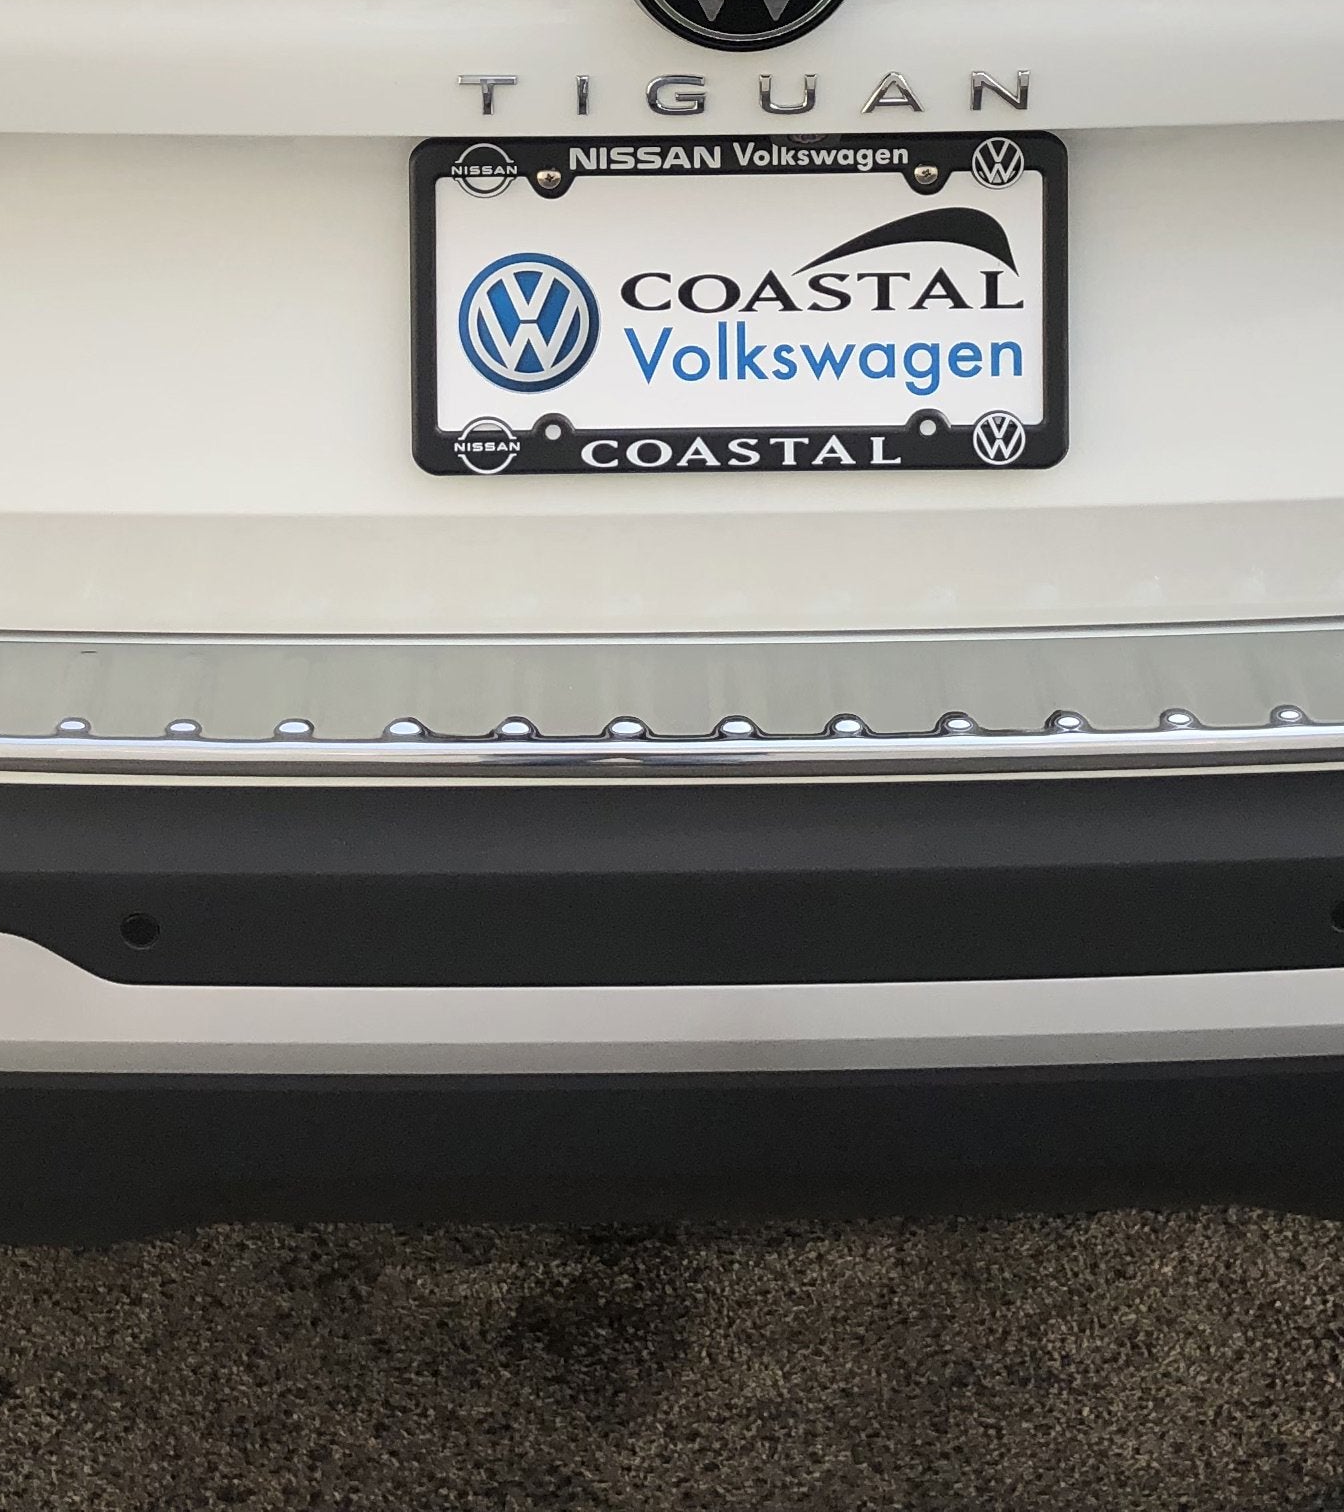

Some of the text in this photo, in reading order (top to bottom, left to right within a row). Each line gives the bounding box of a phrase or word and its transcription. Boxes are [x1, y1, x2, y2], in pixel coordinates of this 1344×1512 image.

[457, 69, 1030, 116] TIGUAN
[451, 163, 518, 176] NISSAN
[569, 141, 909, 170] NISSAN Volkswagen
[621, 268, 1024, 313] COASTAL
[624, 321, 1022, 396] Volkswagen
[454, 439, 521, 453] NISSAN
[581, 435, 902, 467] COASTAL
